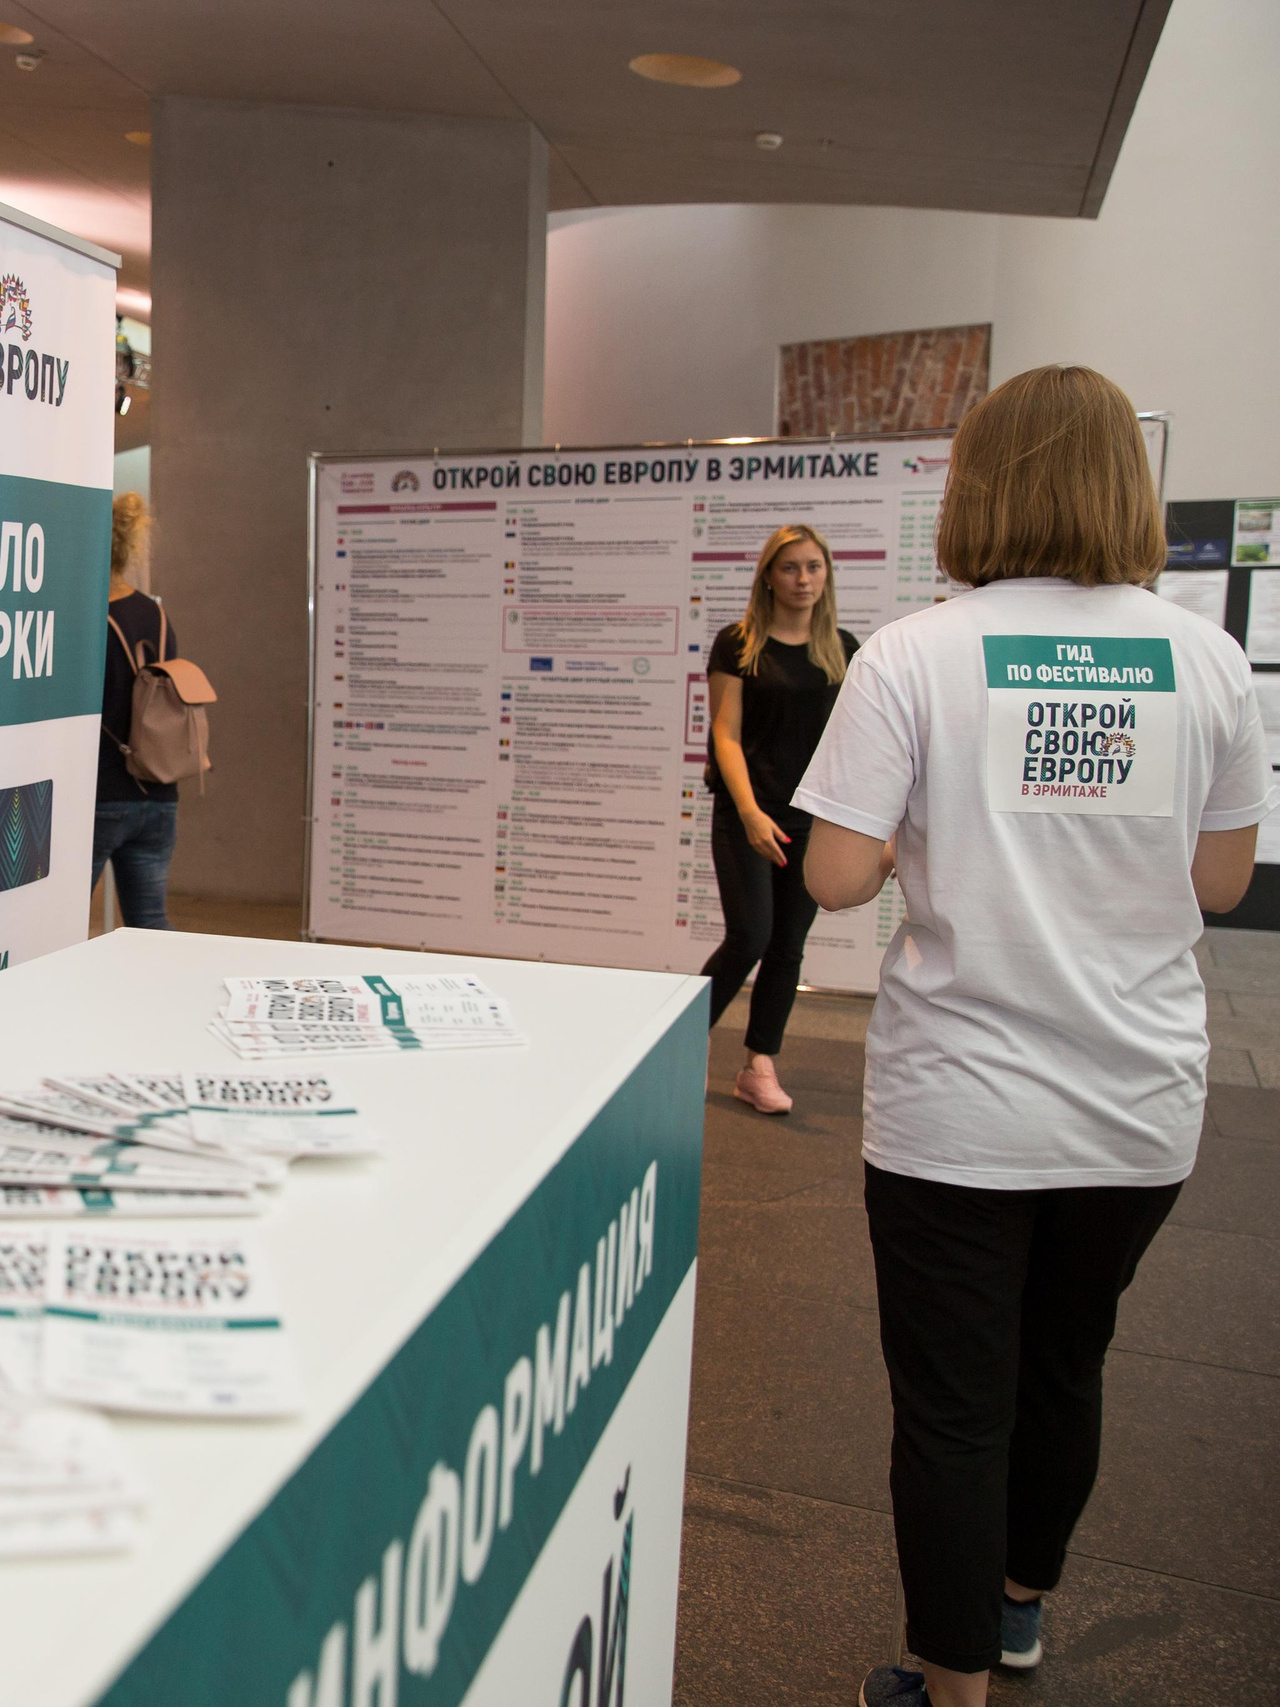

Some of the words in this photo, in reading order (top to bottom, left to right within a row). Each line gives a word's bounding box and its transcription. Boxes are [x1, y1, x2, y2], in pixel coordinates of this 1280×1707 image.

[433, 460, 520, 489] ОТКРОЙ
[528, 462, 597, 487] СВОЮ
[604, 458, 699, 485] ЕВРОПУ
[706, 459, 721, 482] В
[729, 452, 879, 481] ЭРМИТАЖЕ
[1056, 644, 1094, 664] ГИД
[1007, 664, 1032, 681] ПО
[1036, 664, 1154, 684] ФЕСТИВАЛЮ
[1027, 697, 1136, 729] ОТКРОЙ
[1025, 729, 1107, 757] СВОЮ
[1022, 756, 1134, 785] ЕВРОПУ
[1021, 784, 1030, 796] В
[1032, 784, 1107, 798] ЭРМИТАЖЕ
